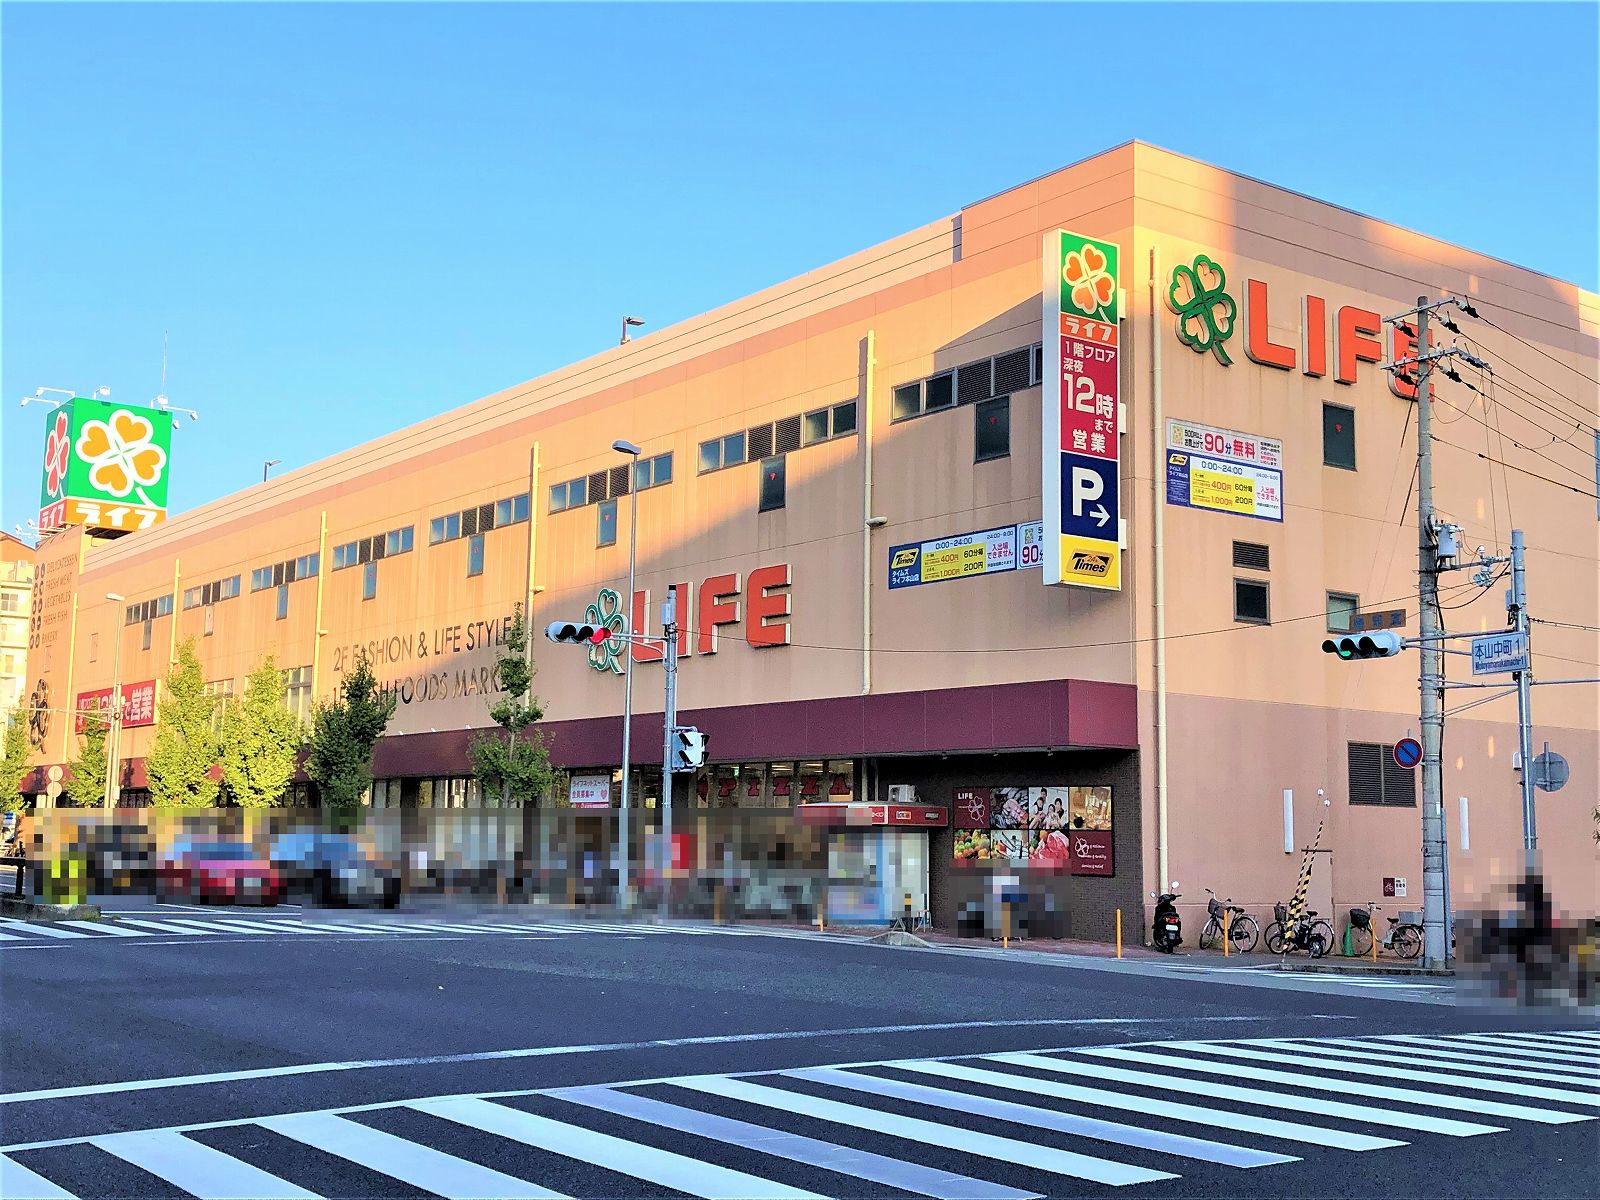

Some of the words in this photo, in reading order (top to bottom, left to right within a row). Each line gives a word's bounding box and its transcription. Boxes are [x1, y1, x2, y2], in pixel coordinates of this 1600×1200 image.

[1065, 316, 1112, 341] ライフ
[1243, 278, 1435, 402] LIFE
[1063, 357, 1084, 373] 深夜
[1072, 428, 1106, 453] 営業
[1072, 466, 1104, 517] P
[41, 503, 65, 528] ライフ
[76, 503, 158, 530] ライフ
[1072, 555, 1106, 573] Times
[631, 564, 792, 663] LIFE
[334, 646, 348, 671] 2F
[352, 634, 412, 669] FASHION
[417, 631, 428, 658] &
[434, 625, 461, 656] LIFE
[466, 616, 512, 651] STYLE
[718, 774, 851, 797] PIZZA
[957, 792, 973, 800] LIFE
